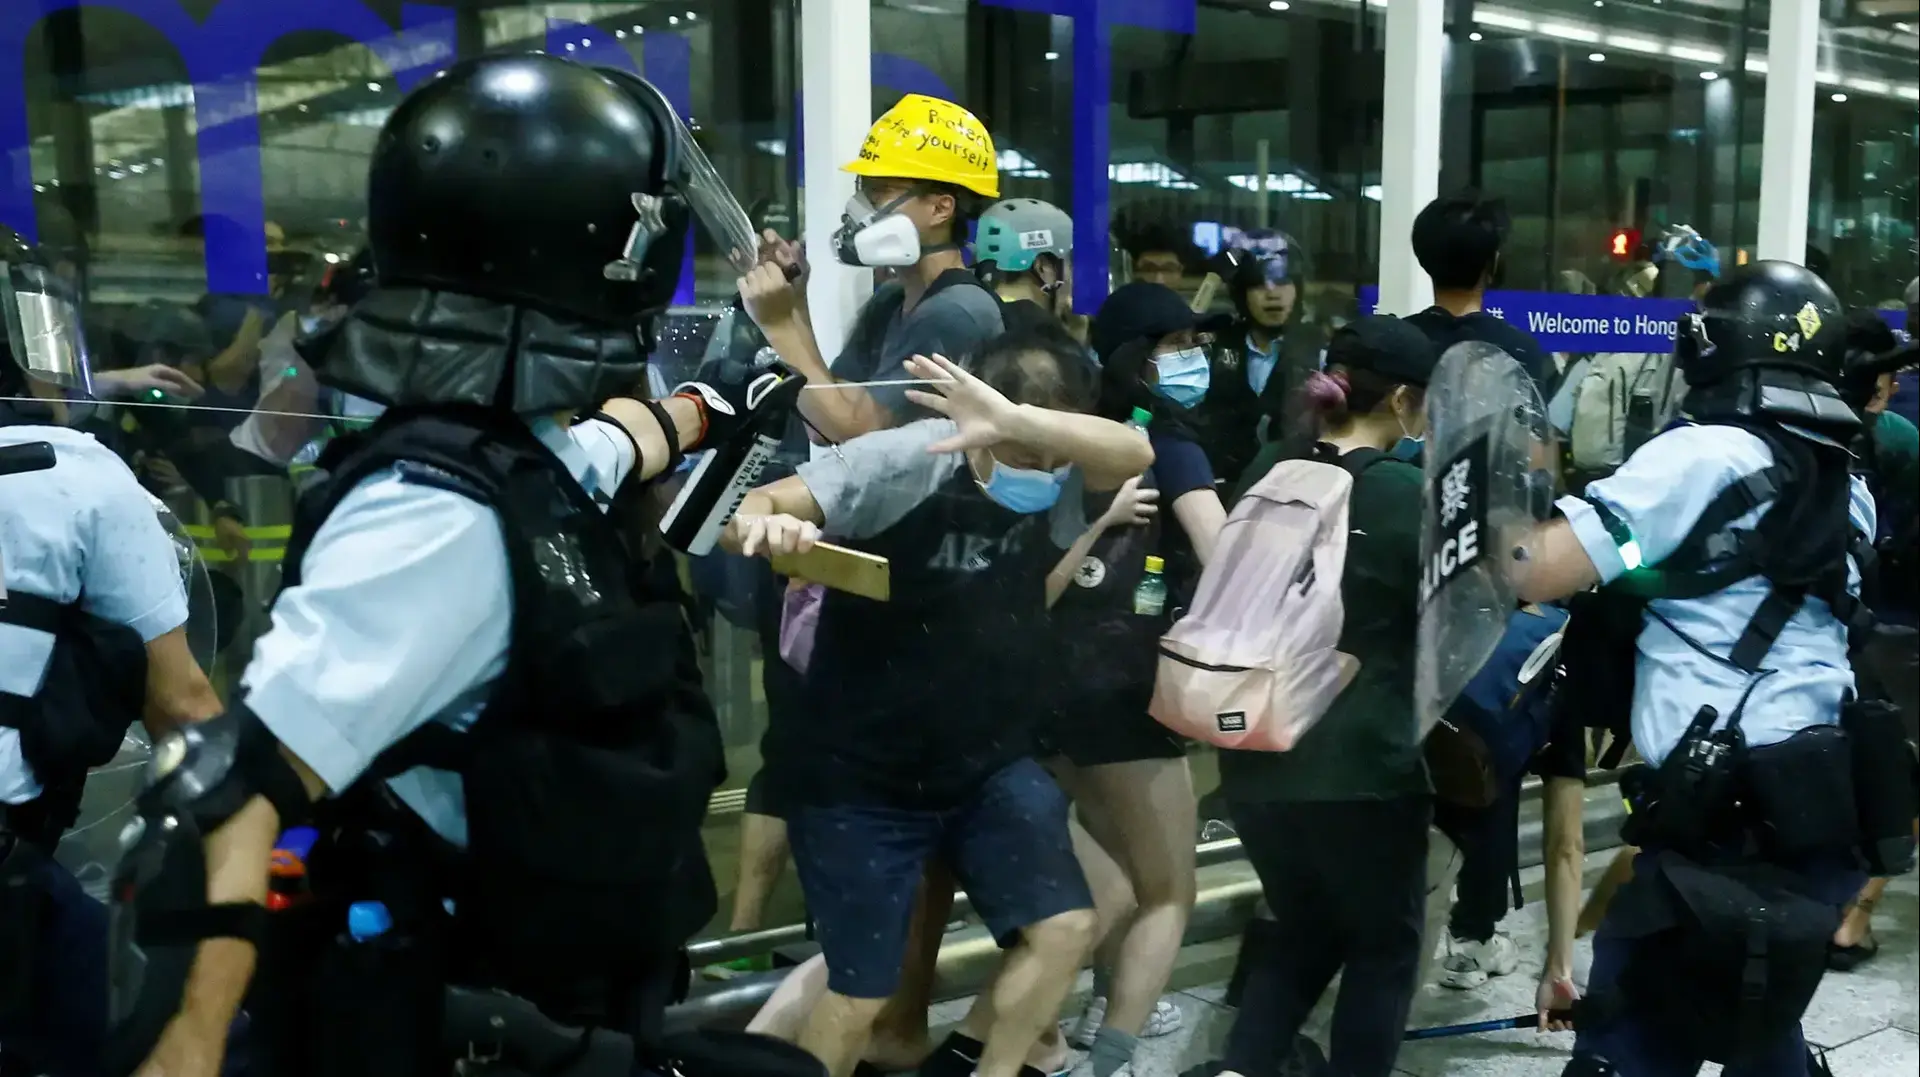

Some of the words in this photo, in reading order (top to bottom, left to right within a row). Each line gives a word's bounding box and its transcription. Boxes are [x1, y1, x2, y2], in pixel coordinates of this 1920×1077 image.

[916, 134, 988, 171] yourself
[1528, 311, 1609, 334] Welcome
[1614, 316, 1630, 335] to
[1635, 314, 1678, 341] Hong
[1420, 519, 1479, 602] LICE
